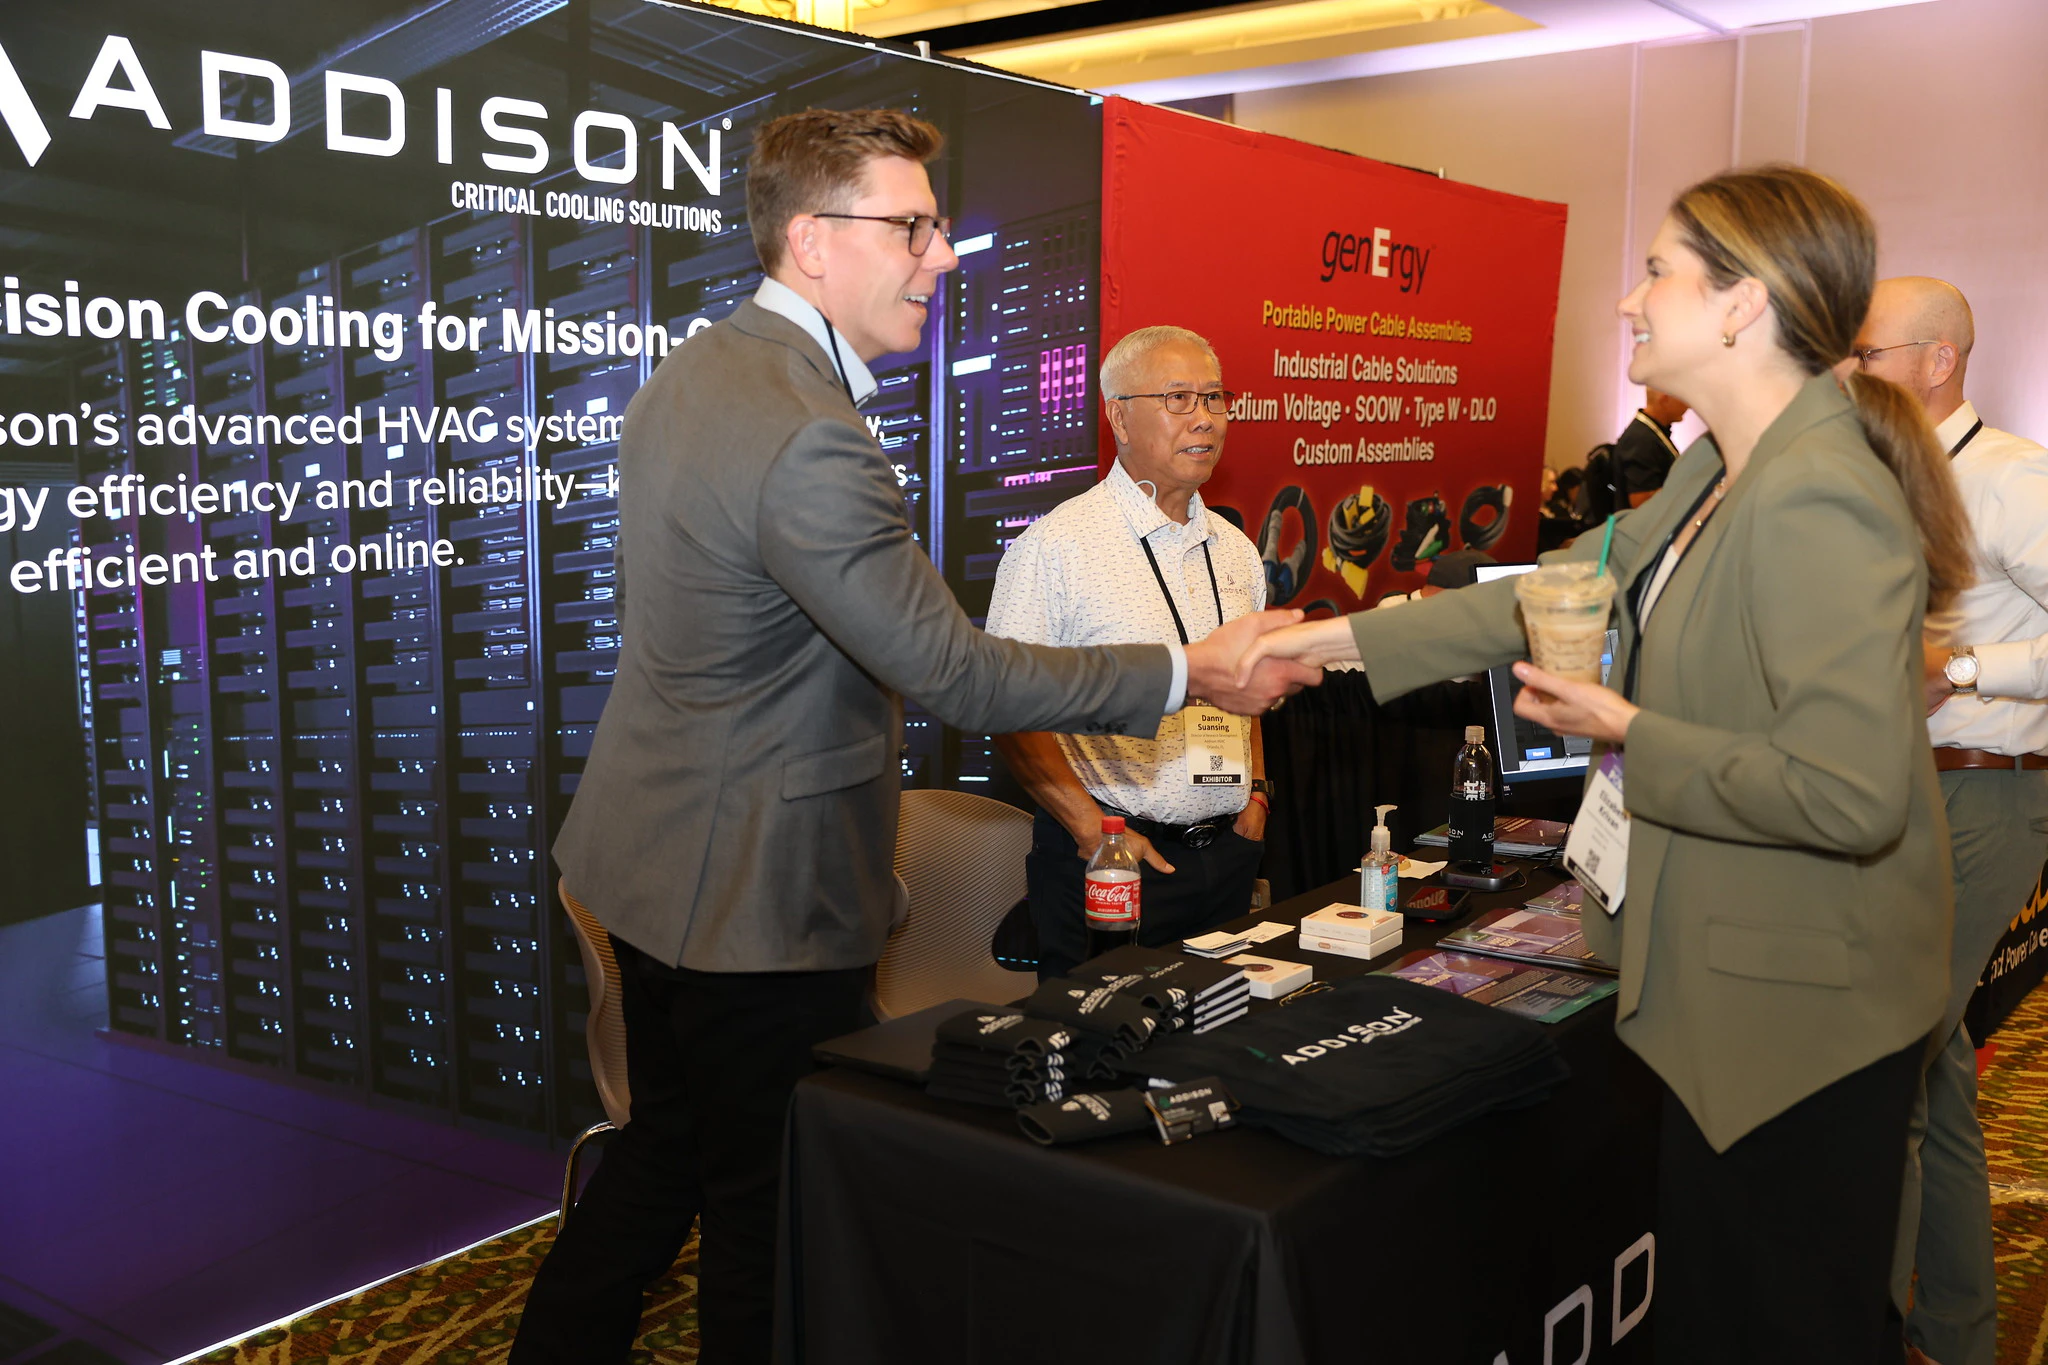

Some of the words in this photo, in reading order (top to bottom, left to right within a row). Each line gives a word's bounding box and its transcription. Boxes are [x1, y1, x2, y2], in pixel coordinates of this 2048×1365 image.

[451, 181, 541, 216] CRITICAL
[546, 191, 624, 223] COOLING
[628, 200, 722, 233] SOLUTIONS
[1320, 227, 1431, 295] genErgy
[0, 276, 164, 340] ision
[185, 291, 404, 362] Cooling
[418, 301, 488, 352] for
[1263, 300, 1323, 331] Portable
[1326, 307, 1368, 334] Power
[1370, 311, 1406, 338] Cable
[1407, 318, 1473, 344] Assemblies
[1274, 349, 1348, 381] Industrial
[1352, 354, 1393, 383] Cable
[1396, 357, 1458, 385] Solutions
[137, 401, 363, 446] advanced
[378, 406, 498, 444] HVAC
[1226, 393, 1279, 422] edium
[1284, 395, 1341, 429] Voltage
[1356, 396, 1401, 422] SOOW
[1414, 397, 1445, 428] Type
[1446, 397, 1461, 421] W
[1470, 396, 1497, 422] DLO
[1293, 437, 1353, 467] Custom
[1355, 438, 1435, 466] Assemblies
[67, 474, 302, 522] efficiency
[314, 469, 393, 509] and
[10, 546, 218, 595] efficient
[233, 538, 315, 579] and
[331, 532, 464, 576] online.
[1198, 724, 1230, 732] Suansing
[1202, 715, 1224, 723] Danny
[1089, 884, 1132, 902] Coca-Cola
[2005, 937, 2029, 974] Power
[1281, 1007, 1412, 1066] ADDISON
